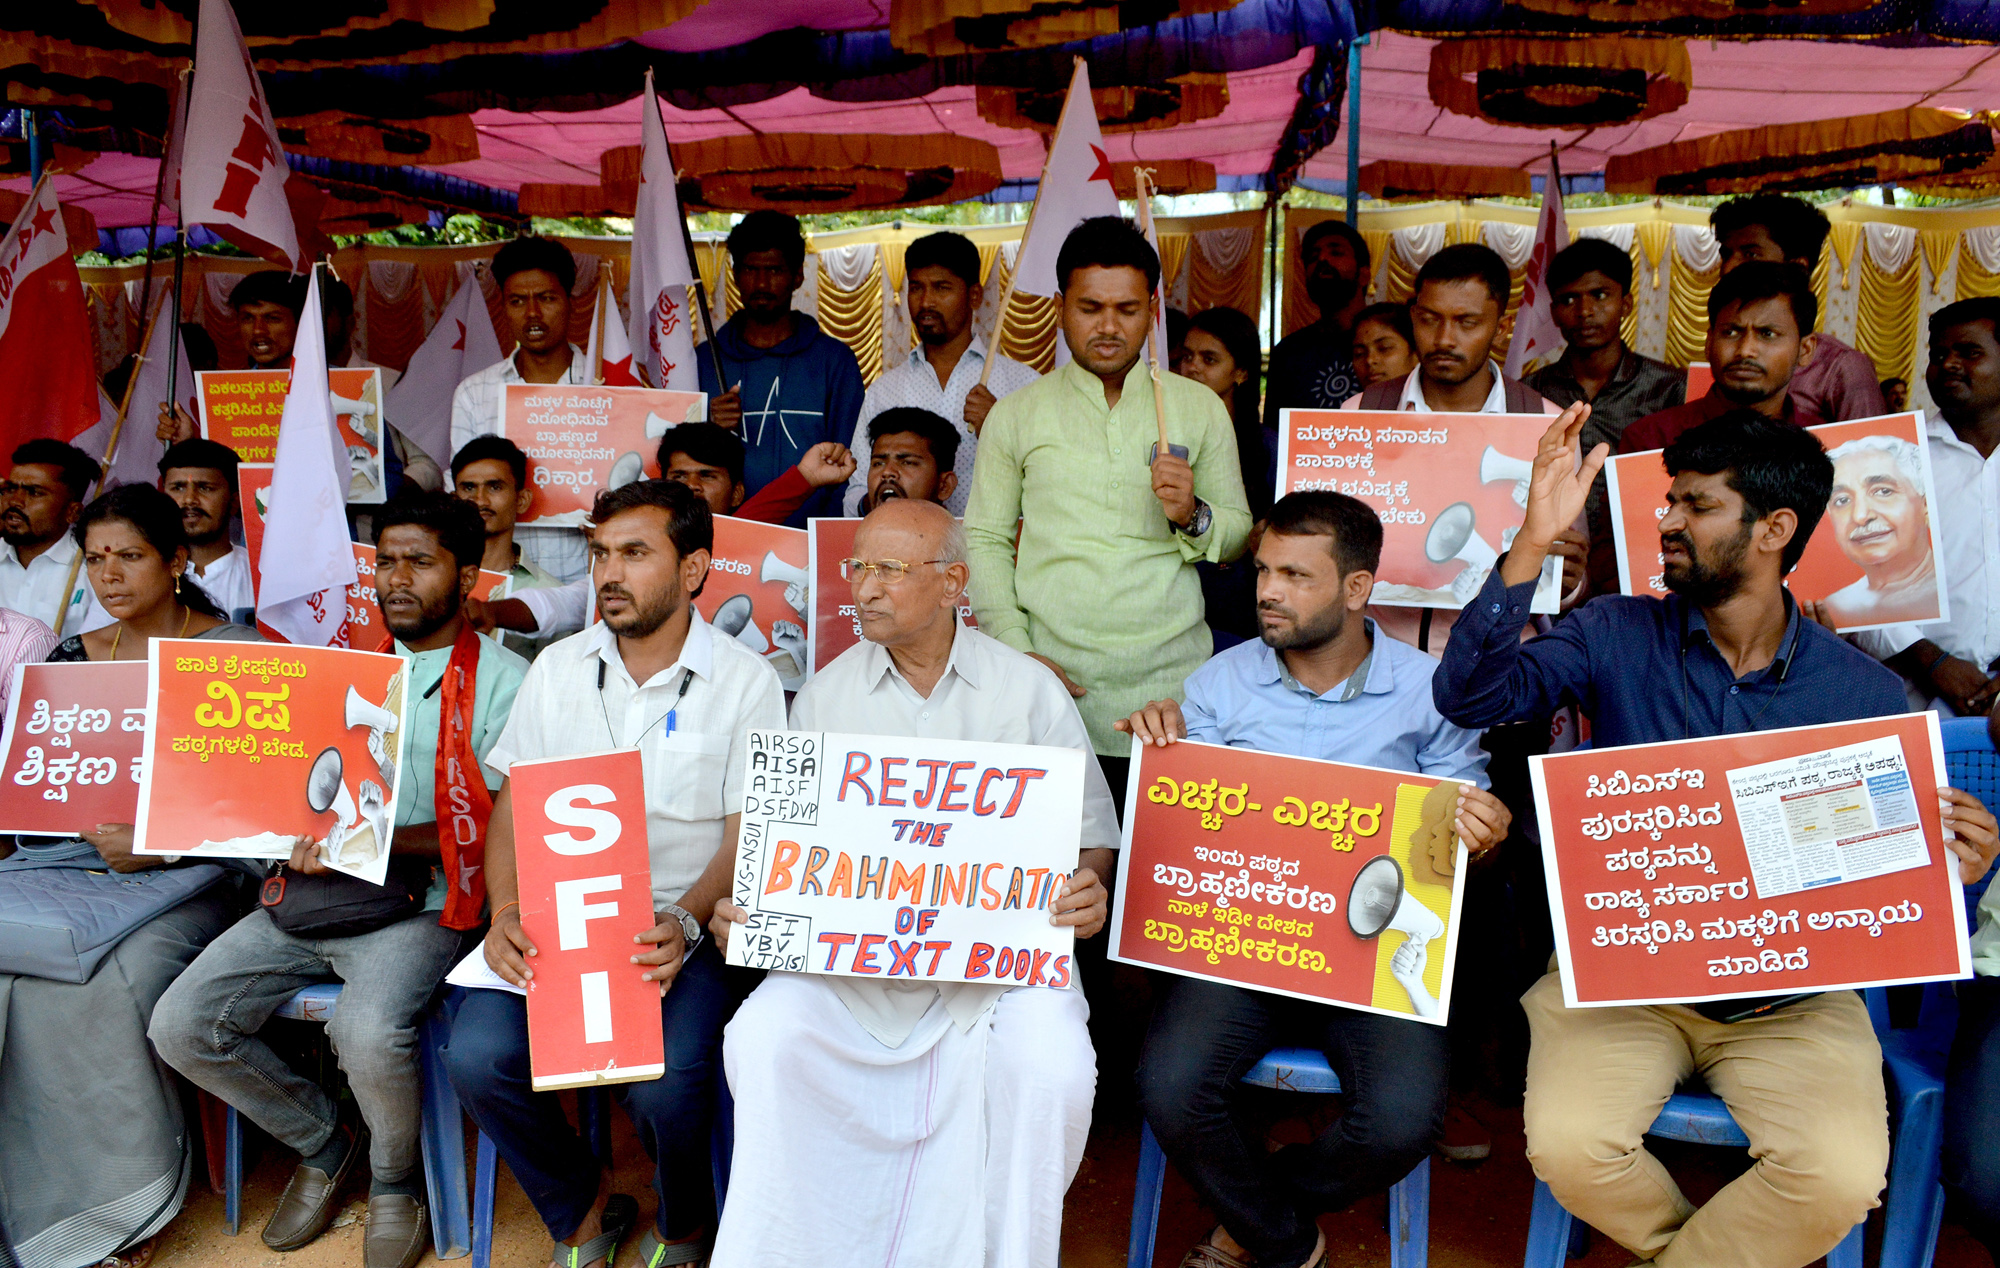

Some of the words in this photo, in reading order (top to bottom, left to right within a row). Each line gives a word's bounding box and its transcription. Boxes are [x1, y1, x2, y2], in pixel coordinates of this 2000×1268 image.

[209, 381, 266, 400] ಏಕಲವ್ಯನ
[524, 395, 563, 412] ಮಕ್ಕಳ
[212, 402, 262, 421] ಕತ್ತರಿಸಿದ
[527, 413, 608, 427] ವಿರೋಧಿಸುವ
[1296, 424, 1373, 450] ಮಕ್ಕಳನ್ನು
[1376, 428, 1448, 444] ಸನಾತನ
[1296, 452, 1376, 476] ಪಾತಾಳಕ್ಕೆ
[533, 466, 598, 494] ಧಿಕ್ಕಾರ.
[1342, 480, 1410, 504] ಭವಿಷ್ಯಕ್ಕೆ
[176, 656, 219, 674] ಜಾತಿ
[224, 658, 307, 684] ಶ್ರೇಷ್ಠತೆಯ
[194, 680, 292, 734] ವಿಷ
[26, 699, 112, 748] ಶಿಕ್ಷಣ
[172, 734, 260, 763] ಪಠ್ಯಗಳಲ್ಲಿ
[262, 740, 309, 759] ಬೇಡ.
[750, 732, 815, 756] AIRSO
[14, 746, 116, 802] ಶಿಕ್ಷಣ
[753, 752, 816, 777] AISA
[1828, 763, 1864, 780] ರಾಜ್ಯಕ್ಕೆ
[754, 775, 810, 796] AISF
[837, 751, 1048, 818] REJECT
[1148, 776, 1262, 830] ಎಚ್ಚರ-
[1272, 796, 1382, 852] ಎಚ್ಚರ
[1581, 802, 1722, 840] ಪುರಸ್ಕರಿಸಿದ
[892, 820, 952, 847] THE
[1194, 846, 1244, 868] ಇಂದು
[1249, 852, 1300, 882] ಪಠ್ಯದ
[1606, 844, 1716, 879] ಪಠ್ಯವನ್ನು
[1153, 863, 1336, 914] ಬ್ರಾಹ್ಮಣೀಕರಣ
[1584, 886, 1650, 918] ರಾಜ್ಯ
[1654, 876, 1749, 907] ಸರ್ಕಾರ
[542, 784, 622, 1044] SFI
[745, 914, 799, 936] SFI
[895, 906, 940, 936] OF
[1168, 898, 1208, 918] ನಾಳೆ
[1212, 904, 1252, 926] ಇಡೀ
[1256, 914, 1313, 938] ದೇಶದ
[1591, 918, 1694, 954] ತಿರಸ್ಕರಿಸಿ
[1700, 910, 1800, 946] ಮಕ್ಕಳಿಗೆ
[1807, 900, 1923, 938] ಅನ್ಯಾಯ
[744, 933, 790, 952] VBV
[1144, 918, 1332, 974] ಬ್ರಾಹ್ಮಣೀಕರಣ.
[818, 932, 952, 976] TEXT
[964, 942, 1070, 988] BOOKS
[1707, 947, 1809, 978] ಮಾಡಿದೆ
